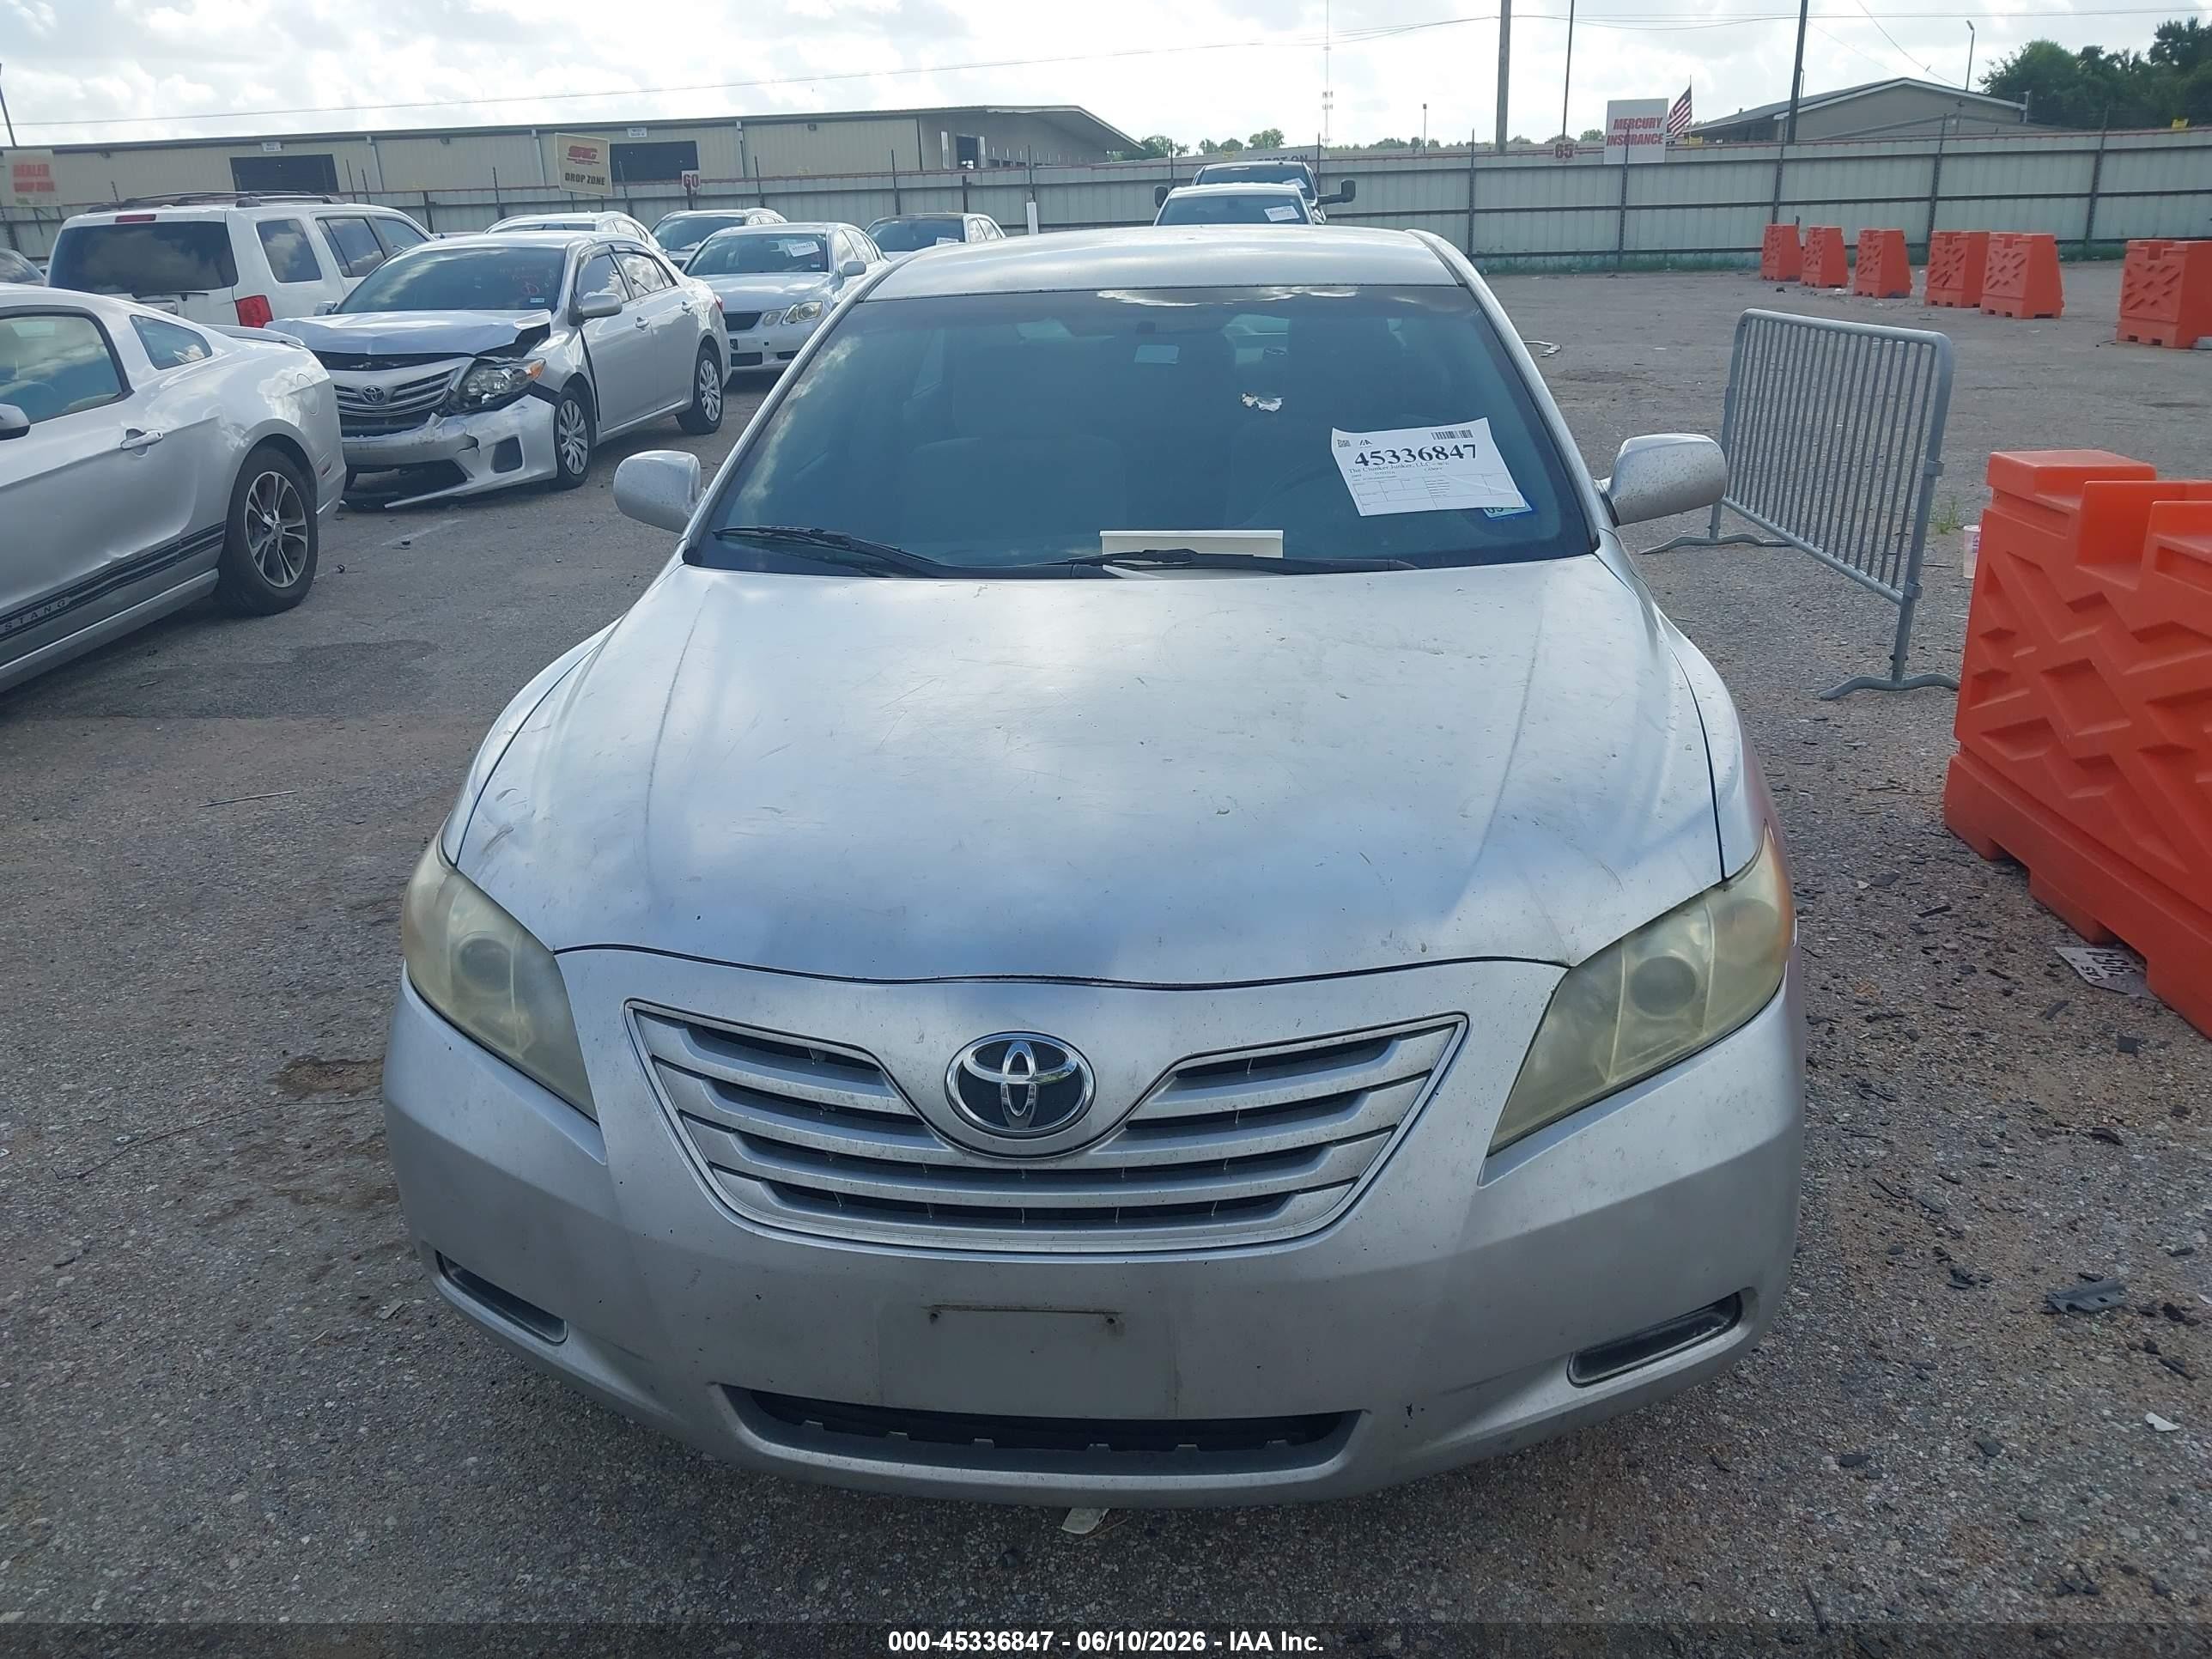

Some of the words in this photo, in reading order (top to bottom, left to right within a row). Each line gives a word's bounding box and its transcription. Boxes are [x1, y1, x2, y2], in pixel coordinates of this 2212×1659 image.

[1613, 117, 1662, 130] MERCURY
[1607, 133, 1663, 146] INSURANCE
[565, 173, 585, 183] DROP
[587, 175, 605, 185] ZONE
[684, 173, 699, 188] 60
[1354, 444, 1477, 466] 45336847
